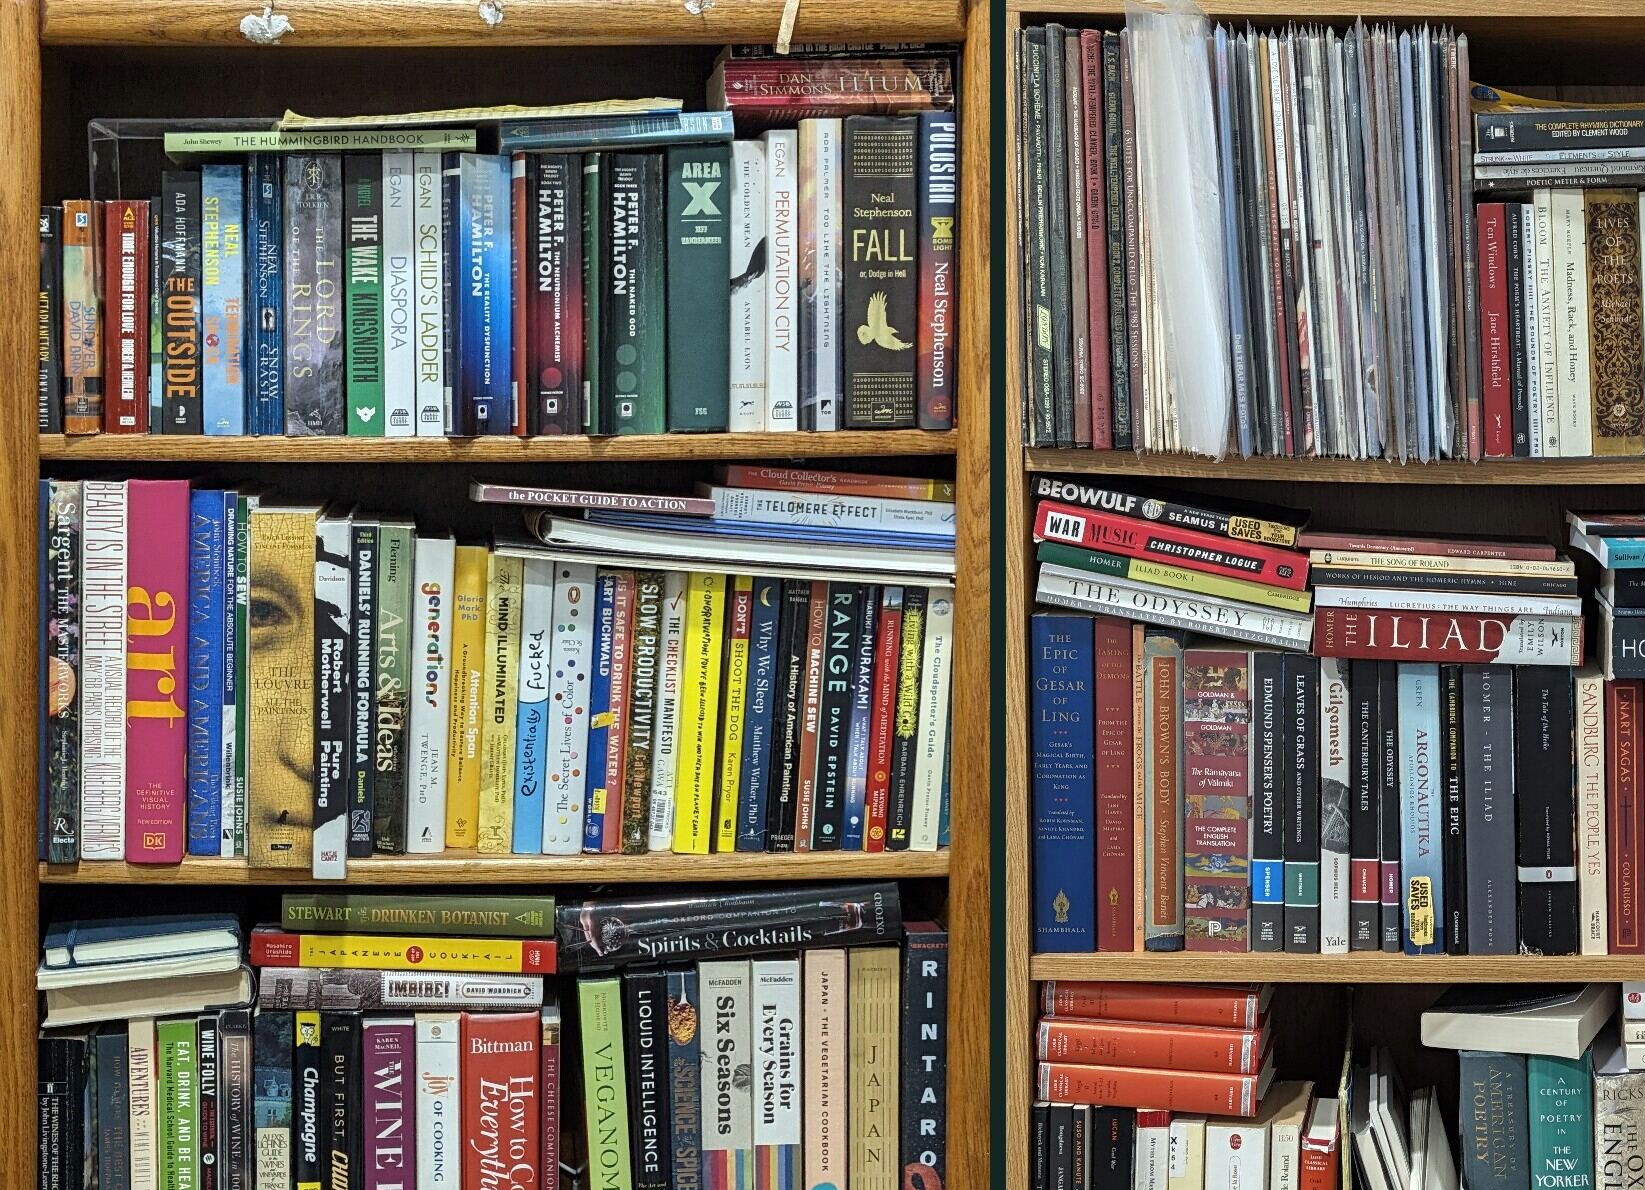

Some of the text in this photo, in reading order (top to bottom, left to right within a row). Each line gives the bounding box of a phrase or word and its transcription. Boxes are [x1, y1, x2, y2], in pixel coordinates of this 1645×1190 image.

[234, 134, 424, 147] THE HUMMINGBIRD HANDBOOK
[682, 163, 721, 178] AREA
[871, 193, 894, 202] Neal
[854, 208, 912, 218] Stephenson
[853, 229, 913, 262] FALL
[1486, 217, 1497, 289] Ten Windows
[527, 492, 686, 510] POCKET GUIDE TO ACTION
[765, 500, 877, 518] TELOMERE EFFECT
[1039, 479, 1137, 514] BEOWULF
[51, 502, 76, 584] Sargent
[1368, 617, 1509, 651] ILIAD
[128, 586, 185, 729] art
[1328, 682, 1341, 768] Gilgamesh
[289, 907, 351, 920] STEWART
[638, 926, 812, 955] Spirits & Cocktails
[717, 996, 737, 1135] Six Seasons
[374, 1063, 403, 1169] WINE
[1545, 1158, 1578, 1170] NEW
[1535, 1174, 1589, 1187] YORKER
